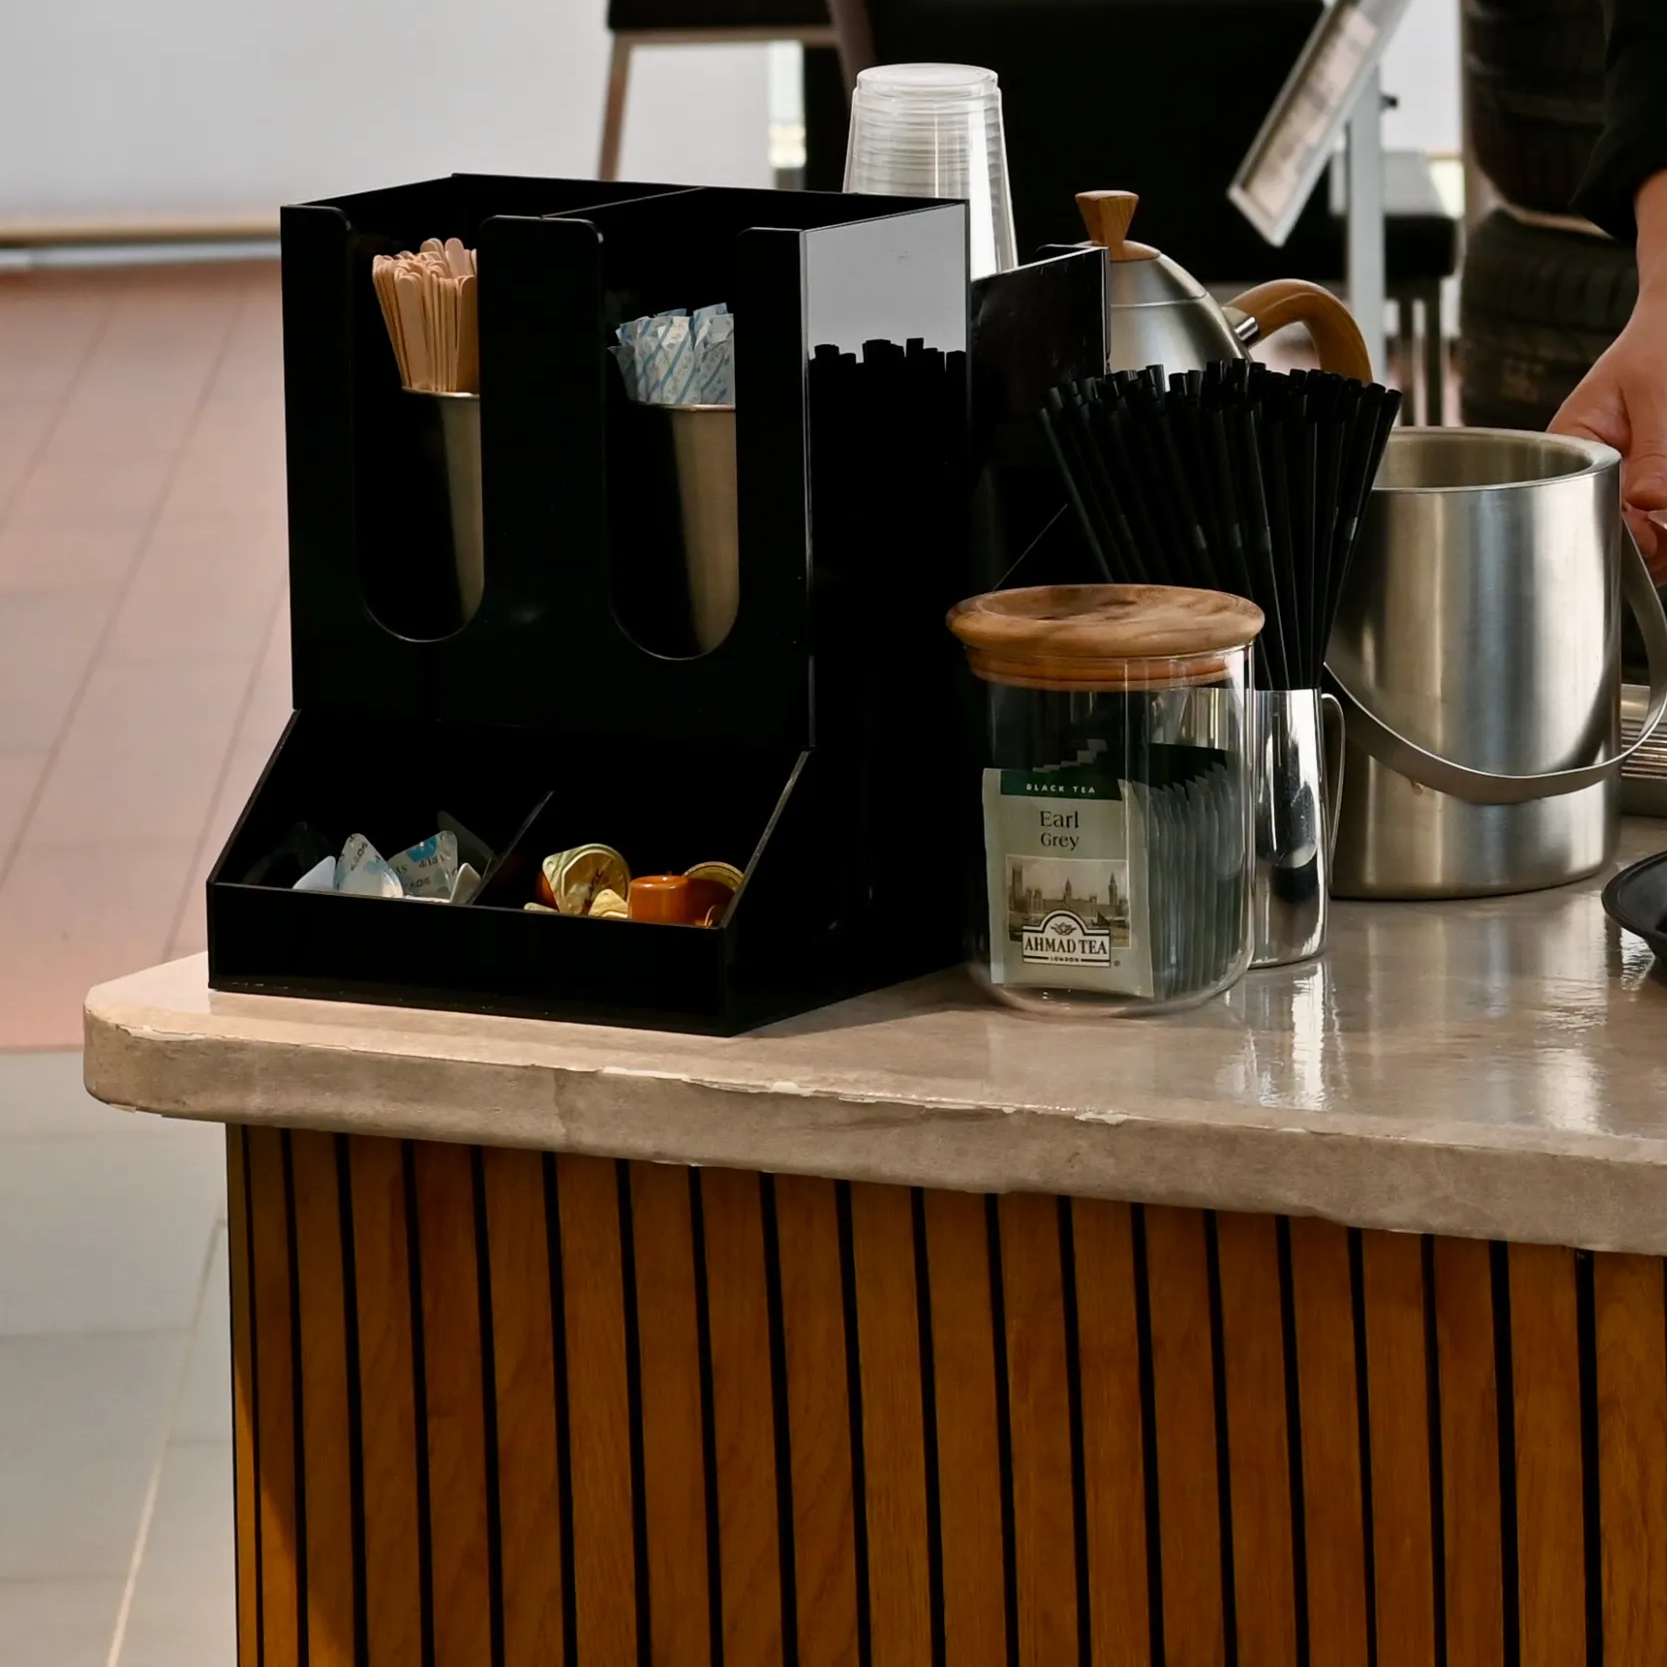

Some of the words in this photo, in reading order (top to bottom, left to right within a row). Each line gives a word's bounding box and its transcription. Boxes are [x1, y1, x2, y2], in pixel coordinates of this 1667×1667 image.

[1025, 783, 1065, 793] BLACK
[1072, 785, 1095, 794] TEA
[1039, 810, 1079, 829] Earl
[1040, 832, 1080, 852] Grey
[1025, 936, 1076, 953] AHMAD
[1079, 940, 1107, 954] TEA
